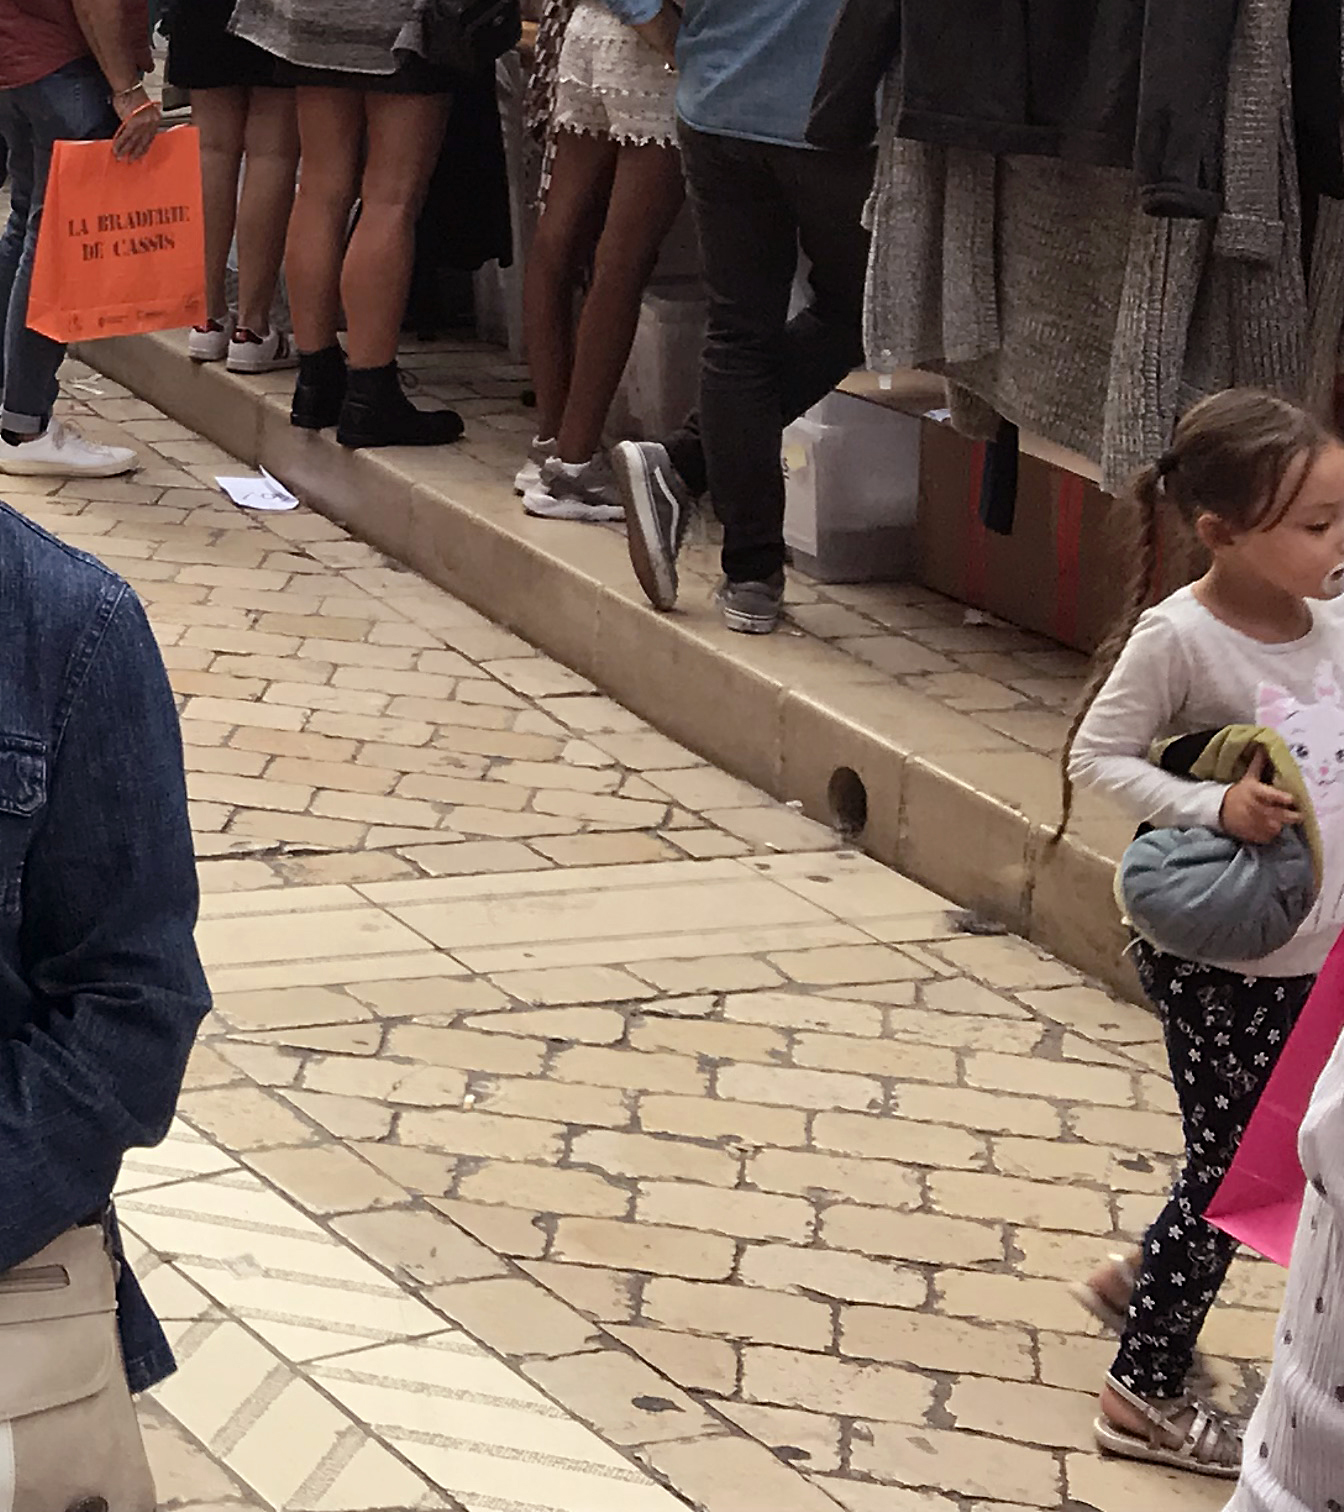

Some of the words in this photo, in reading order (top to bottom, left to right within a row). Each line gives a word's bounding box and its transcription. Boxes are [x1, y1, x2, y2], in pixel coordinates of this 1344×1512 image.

[68, 218, 89, 237] LA
[97, 205, 191, 233] BRADERIE
[82, 241, 104, 261] DE
[113, 233, 175, 257] CASSIS
